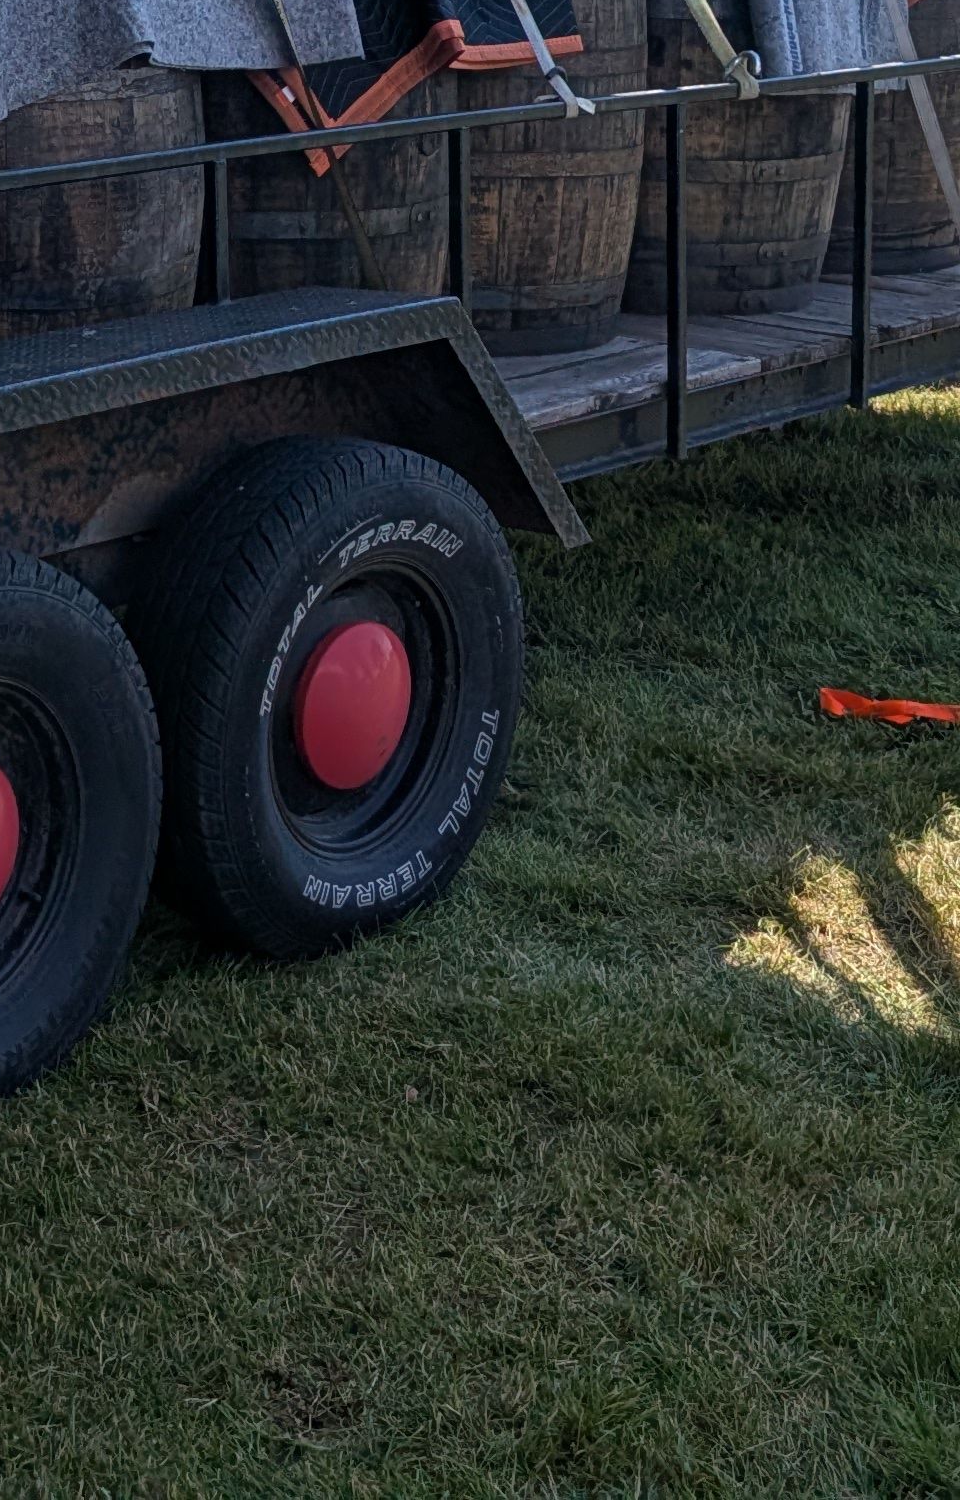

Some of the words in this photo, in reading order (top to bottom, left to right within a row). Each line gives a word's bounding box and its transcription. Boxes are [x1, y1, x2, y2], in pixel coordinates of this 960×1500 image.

[259, 585, 323, 716] TOTAL
[339, 520, 462, 569] TERRAIN
[438, 709, 500, 835] TOTAL
[303, 850, 434, 909] TERRAIN
